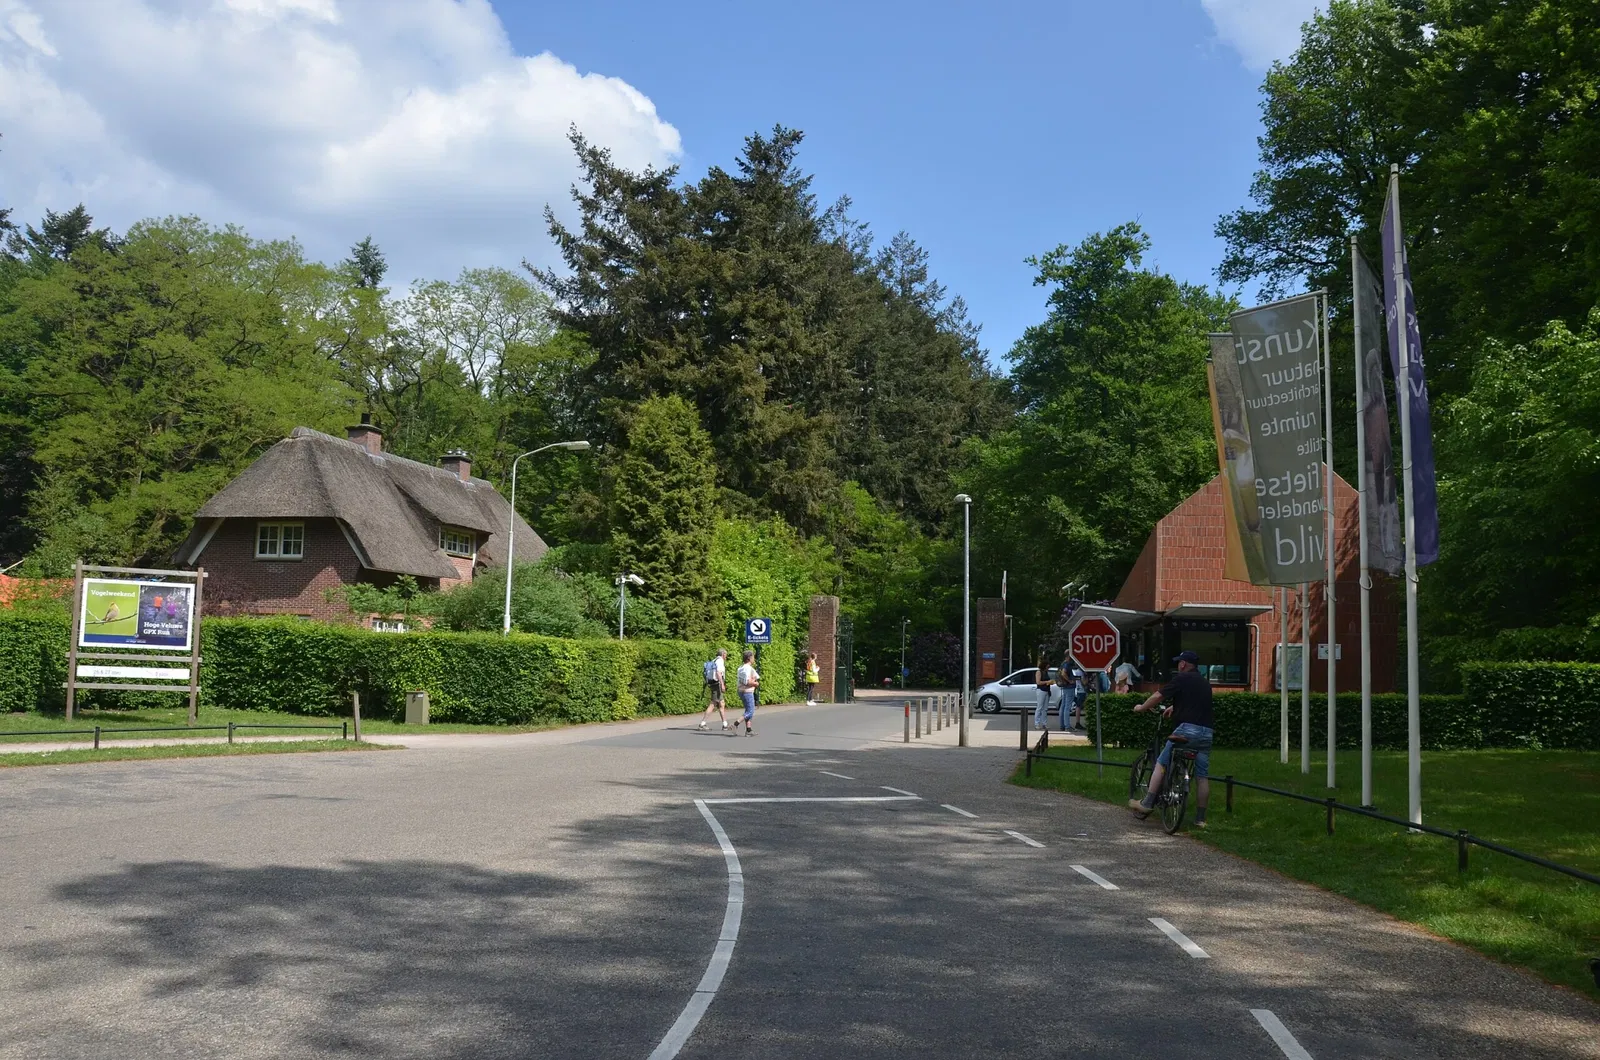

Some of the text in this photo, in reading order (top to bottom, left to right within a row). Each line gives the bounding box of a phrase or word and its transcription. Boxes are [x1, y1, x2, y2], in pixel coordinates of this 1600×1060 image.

[91, 589, 136, 598] Vogelweekend
[144, 621, 160, 629] Hoge
[1073, 634, 1115, 653] STOP
